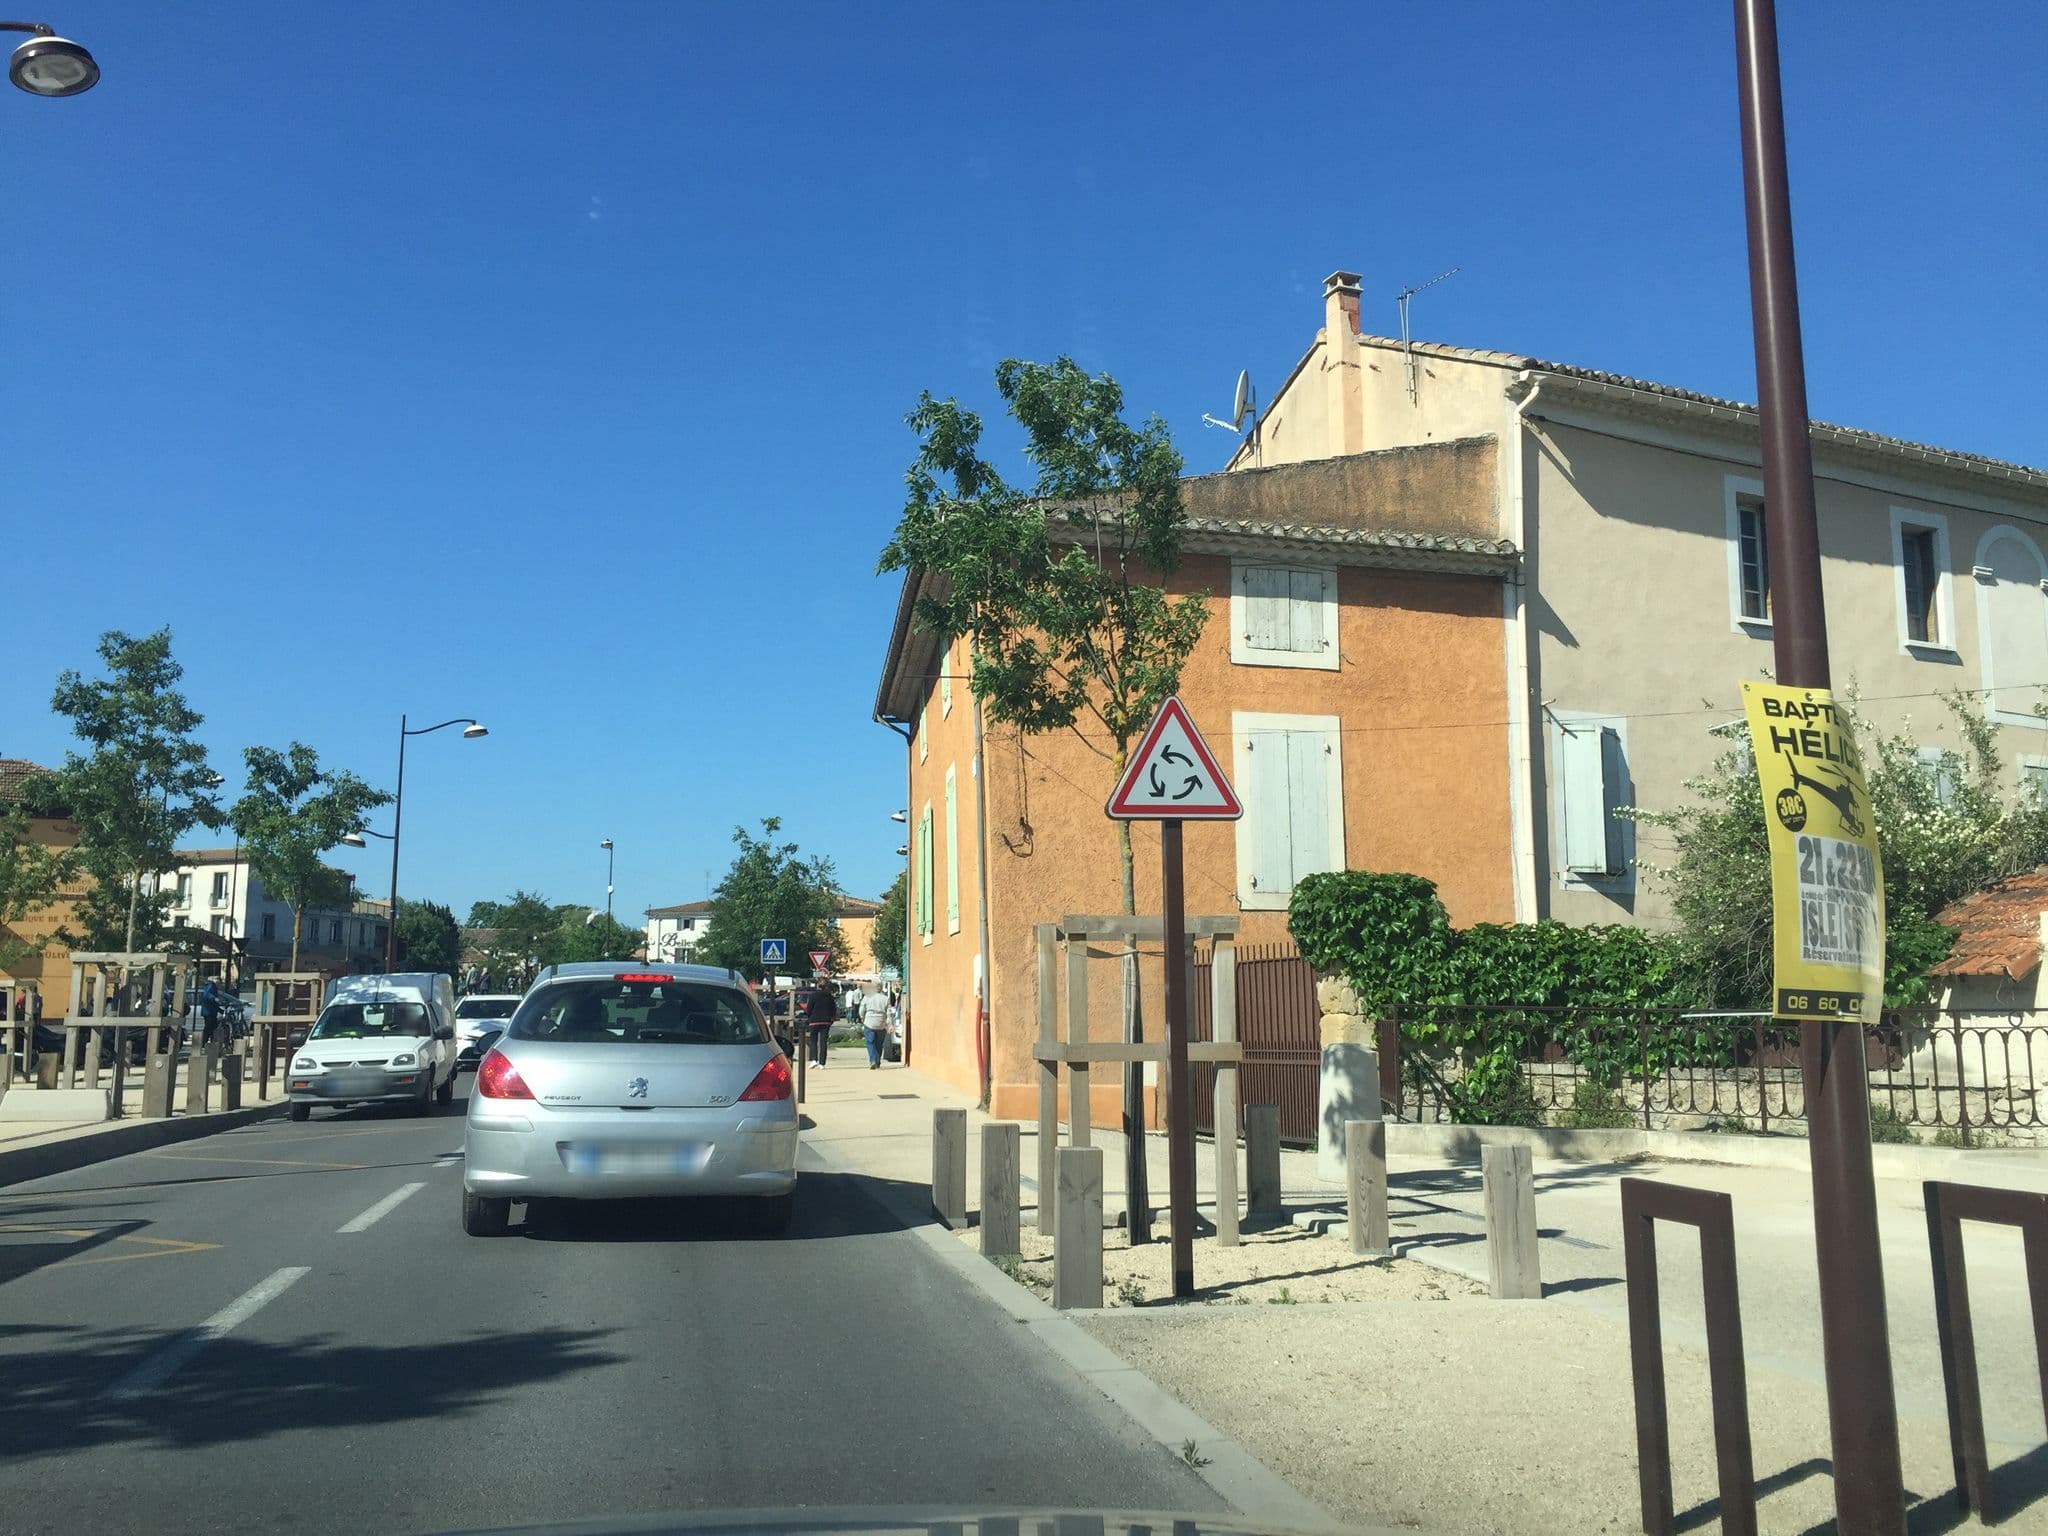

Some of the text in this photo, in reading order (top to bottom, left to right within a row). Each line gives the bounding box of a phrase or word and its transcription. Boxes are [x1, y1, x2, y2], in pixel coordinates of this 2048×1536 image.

[1798, 836, 1825, 886] 21
[1787, 995, 1809, 1010] 06
[1818, 997, 1839, 1011] 60
